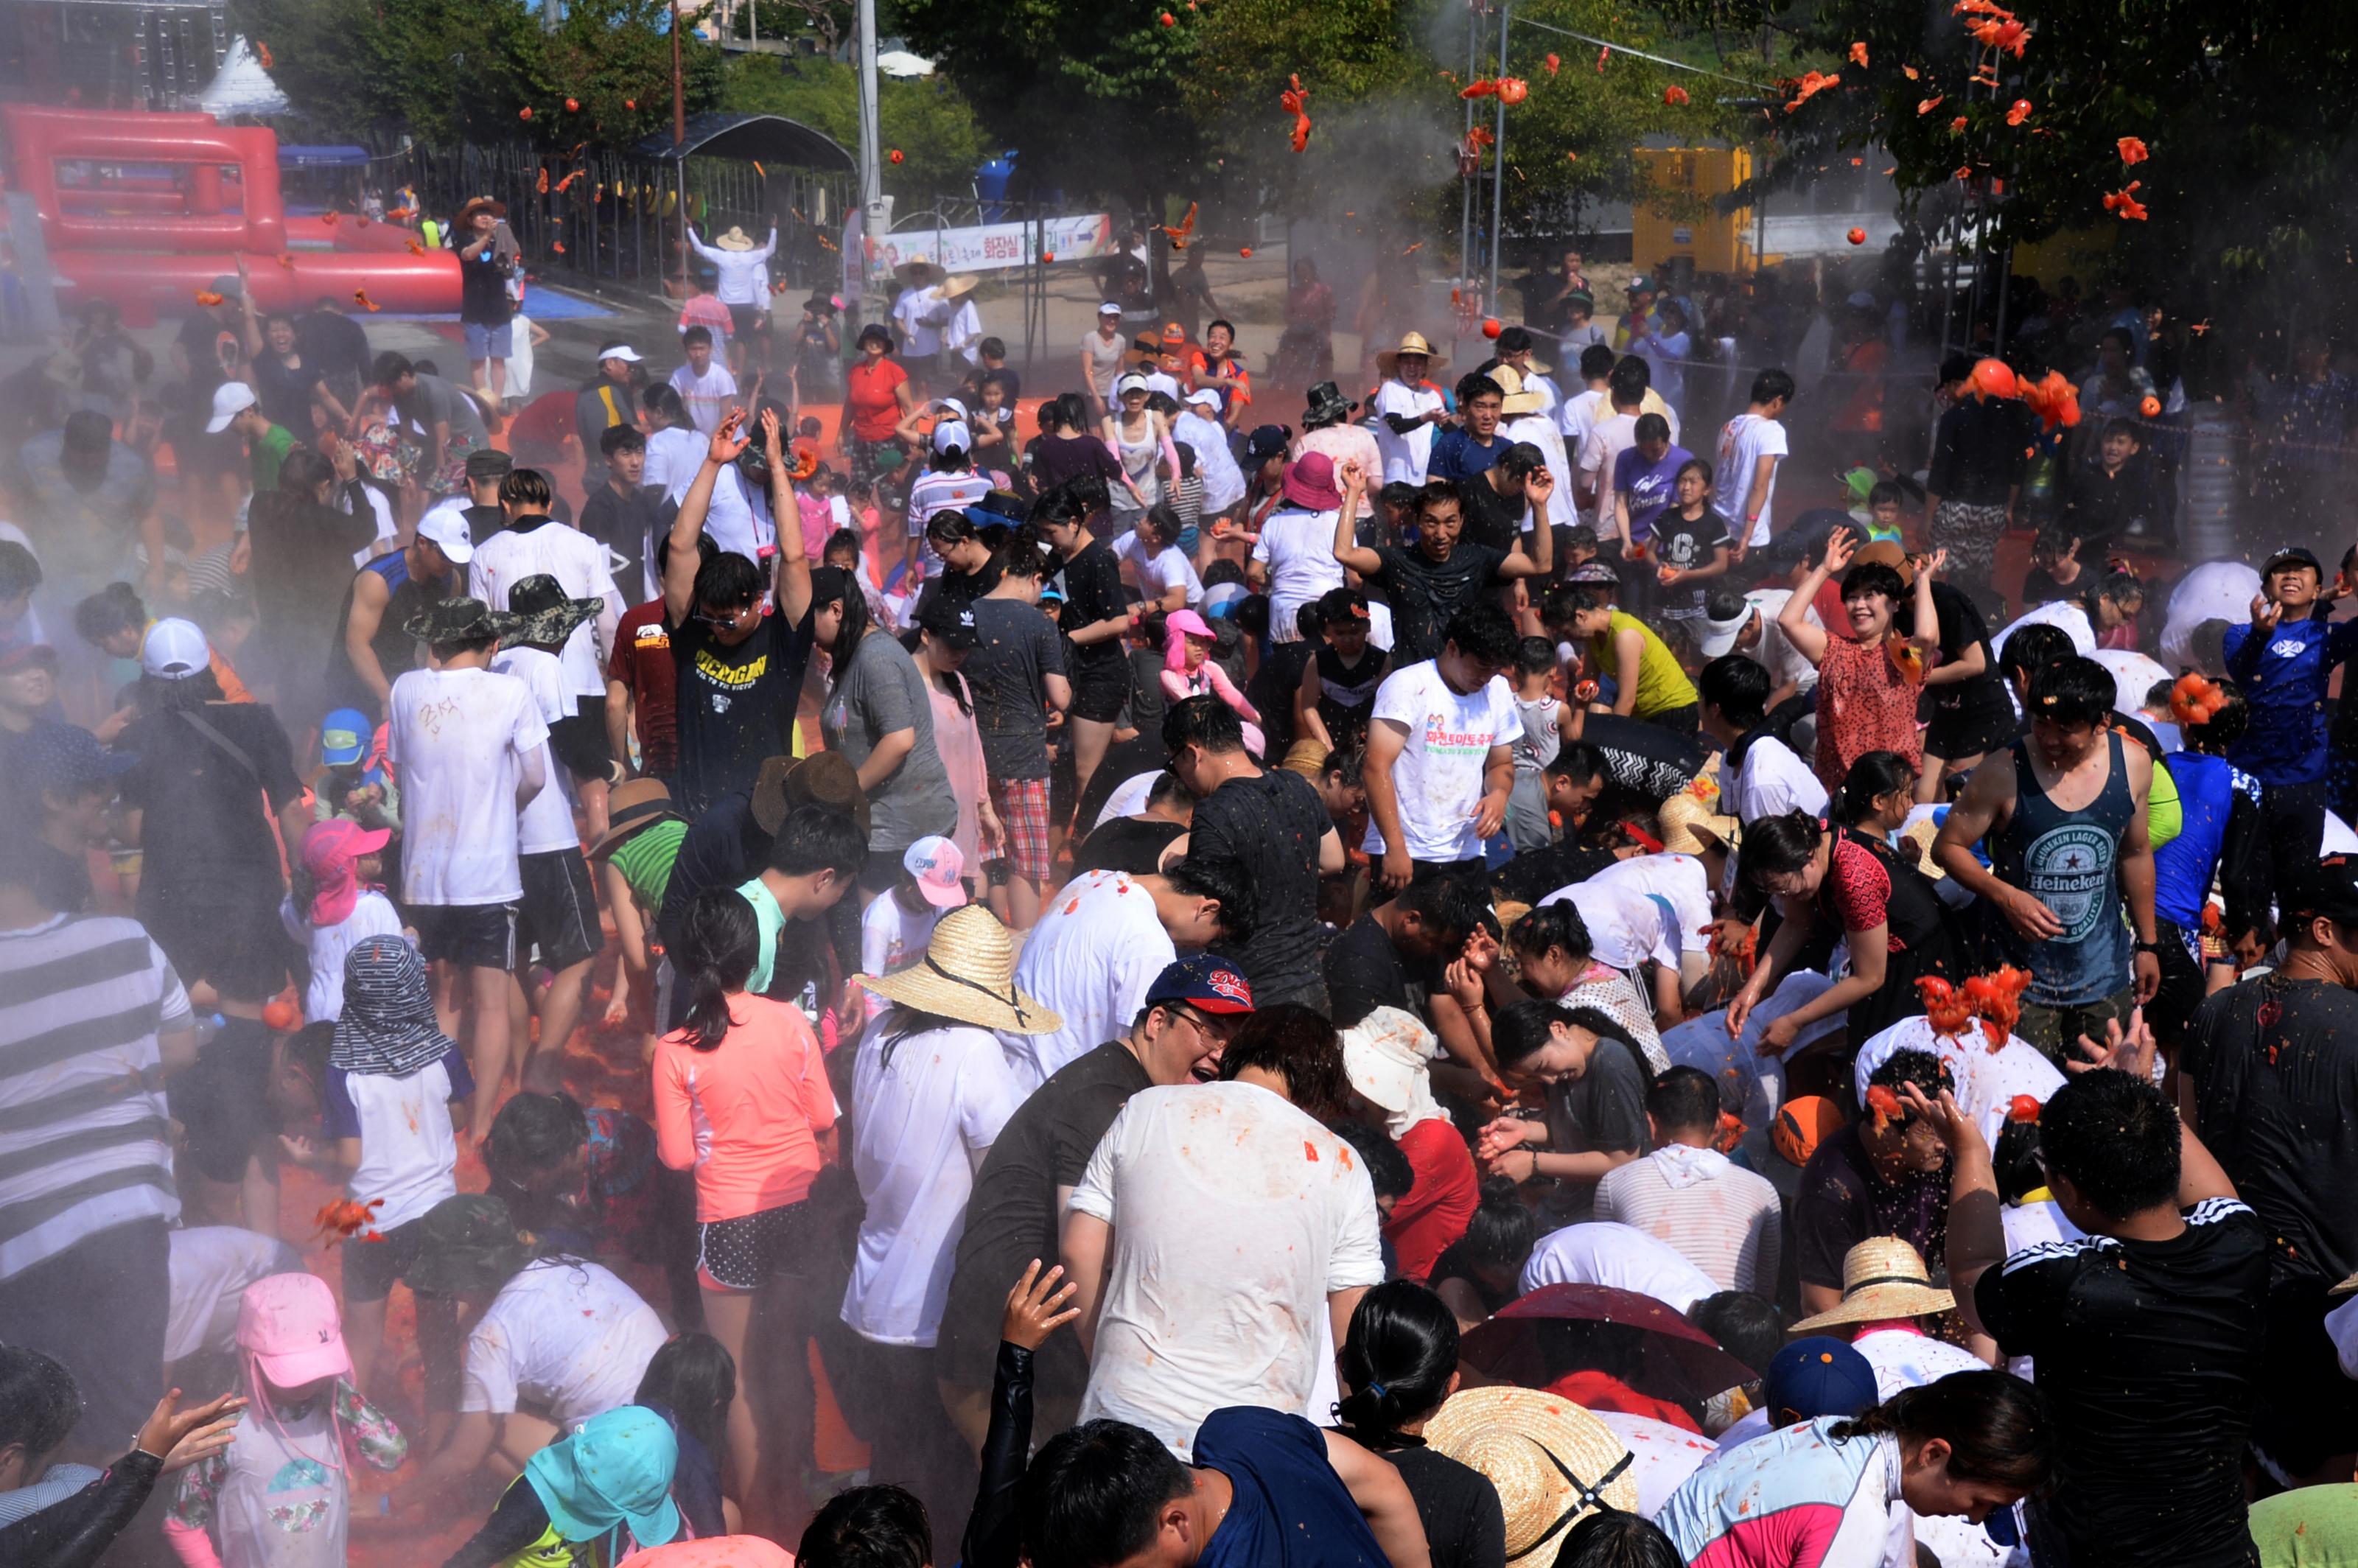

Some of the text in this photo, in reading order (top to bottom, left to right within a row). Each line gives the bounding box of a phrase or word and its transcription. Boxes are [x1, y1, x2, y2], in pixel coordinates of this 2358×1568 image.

[984, 235, 1018, 259] 화장실
[2035, 833, 2069, 865] HEINEKEN
[2071, 831, 2099, 845] LAGER
[2029, 875, 2105, 891] Heineken
